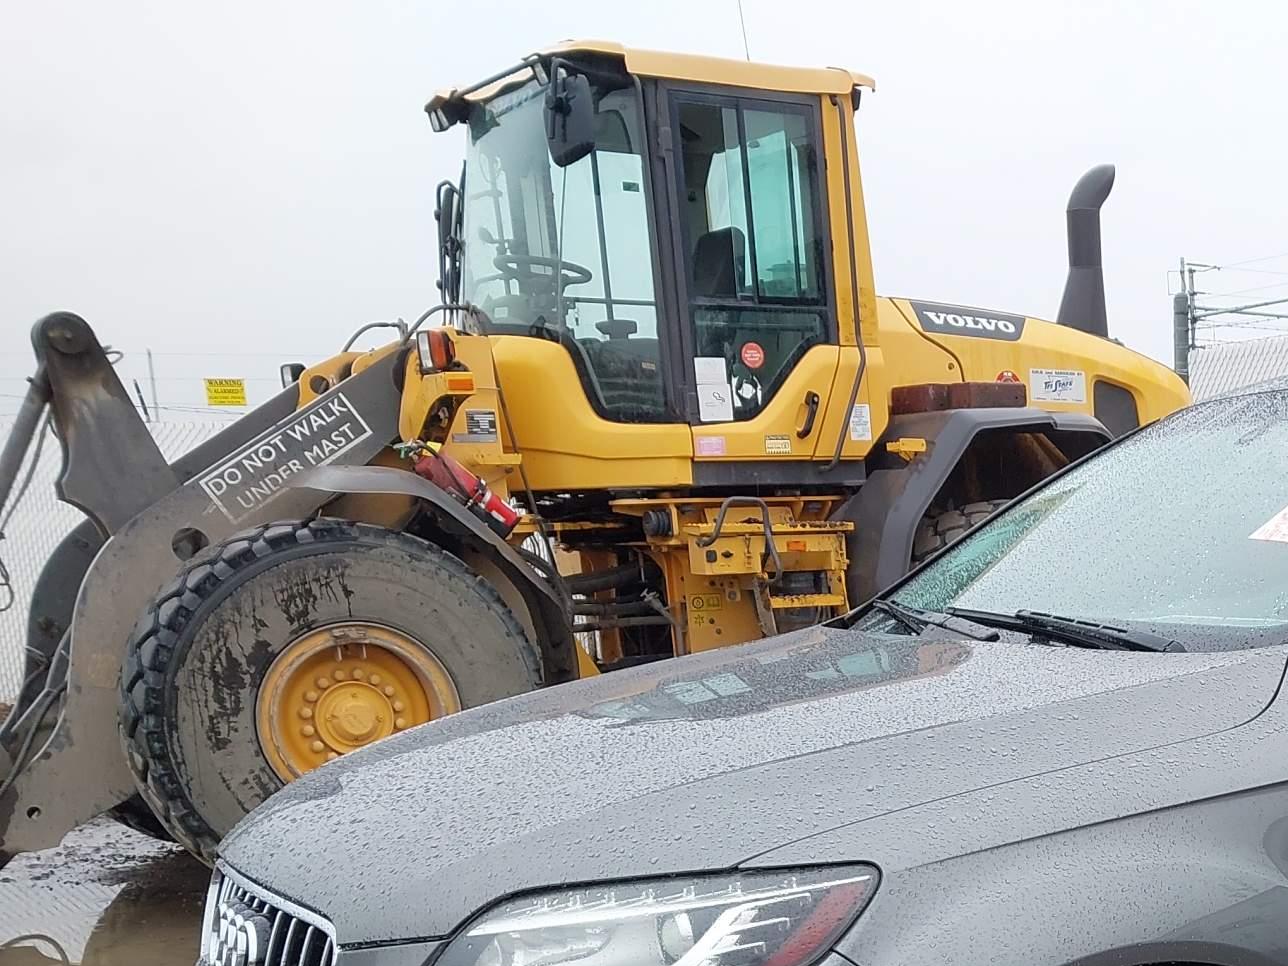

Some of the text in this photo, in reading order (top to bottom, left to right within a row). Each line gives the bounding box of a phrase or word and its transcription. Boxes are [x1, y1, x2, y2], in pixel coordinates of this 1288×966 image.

[922, 310, 1016, 333] VOLVO
[207, 397, 348, 496] DO NOT WALK
[236, 422, 356, 508] UNDER MAST
